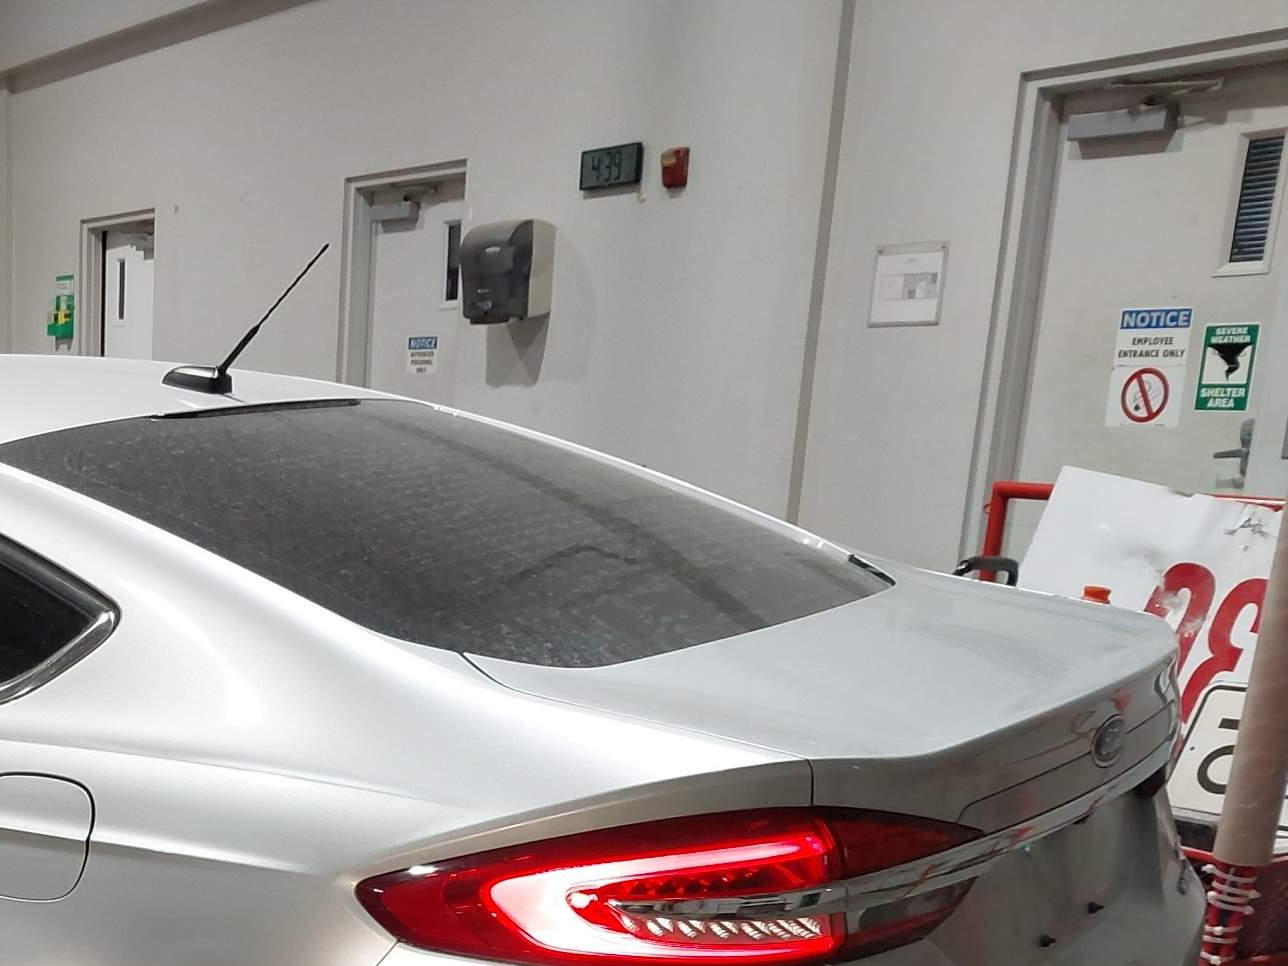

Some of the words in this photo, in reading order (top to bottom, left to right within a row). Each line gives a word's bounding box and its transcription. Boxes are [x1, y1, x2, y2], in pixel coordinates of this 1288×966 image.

[1122, 310, 1190, 328] NOTICE
[1215, 326, 1249, 335] SEVERE
[1132, 336, 1174, 346] EMPLOYEE
[1210, 334, 1252, 344] WEATHER
[1118, 349, 1160, 358] ENTRANCE
[1161, 349, 1185, 358] ONLY
[1199, 386, 1246, 398] SHELTER
[1206, 398, 1235, 408] AREA
